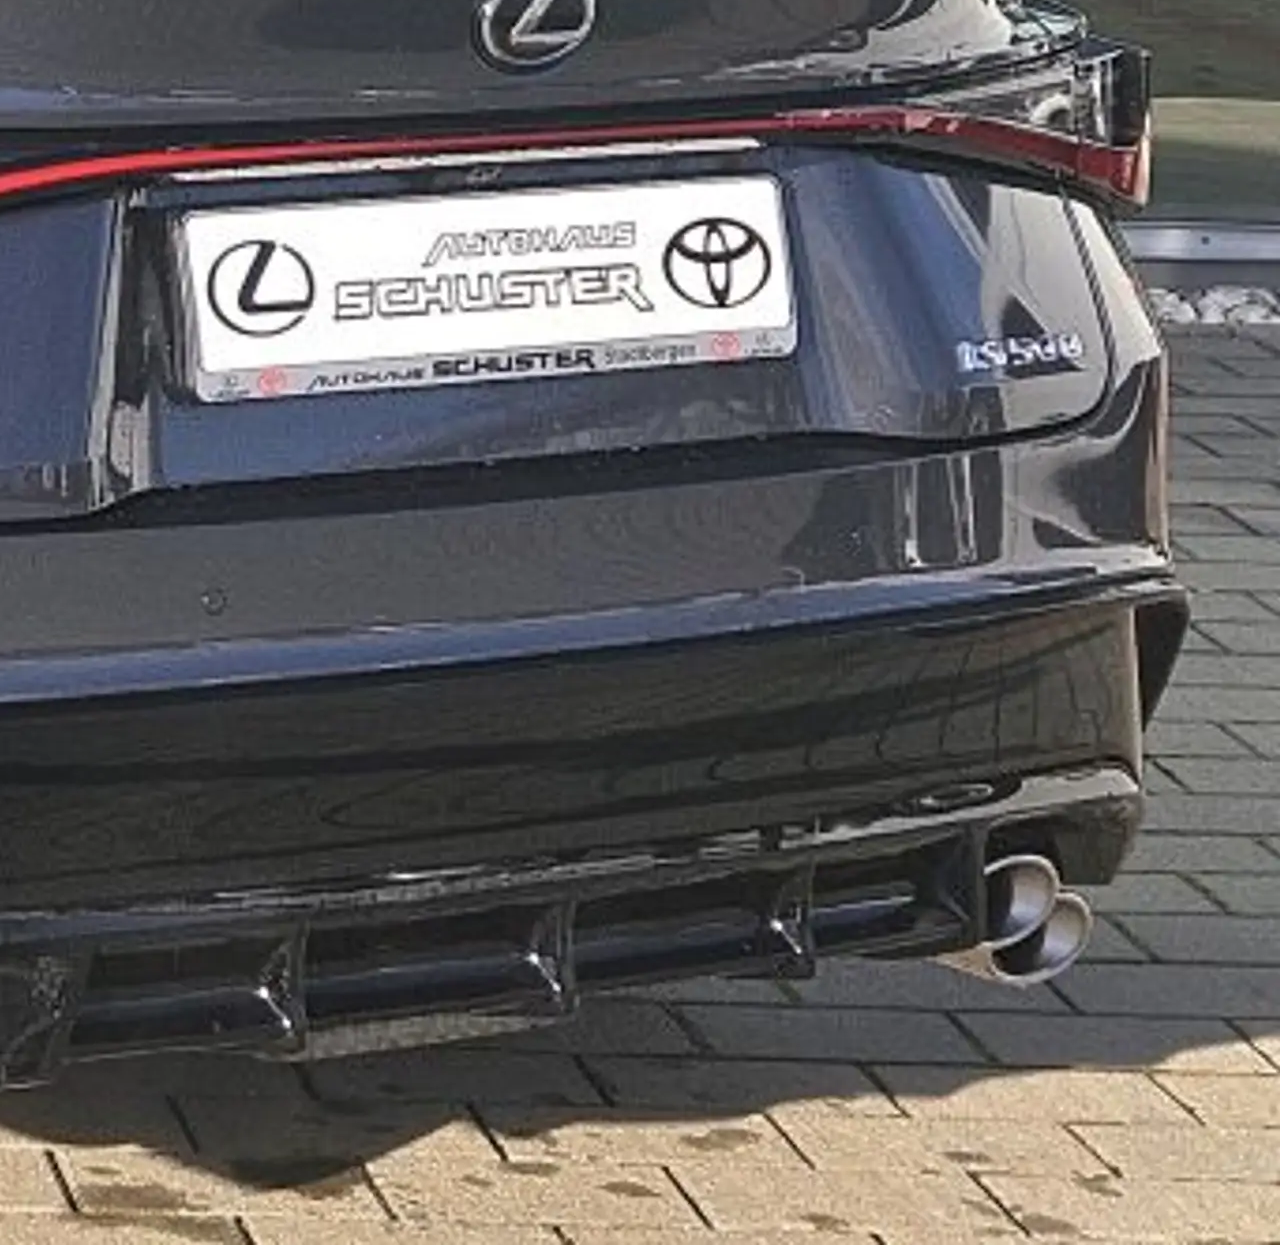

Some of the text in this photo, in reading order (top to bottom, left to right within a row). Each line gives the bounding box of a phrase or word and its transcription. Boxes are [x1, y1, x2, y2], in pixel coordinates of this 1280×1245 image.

[421, 221, 637, 267] AUTOHAUS
[334, 262, 655, 321] SCHUSTER
[306, 367, 424, 392] AUTOHAUS
[432, 348, 596, 378] SCHUSTER
